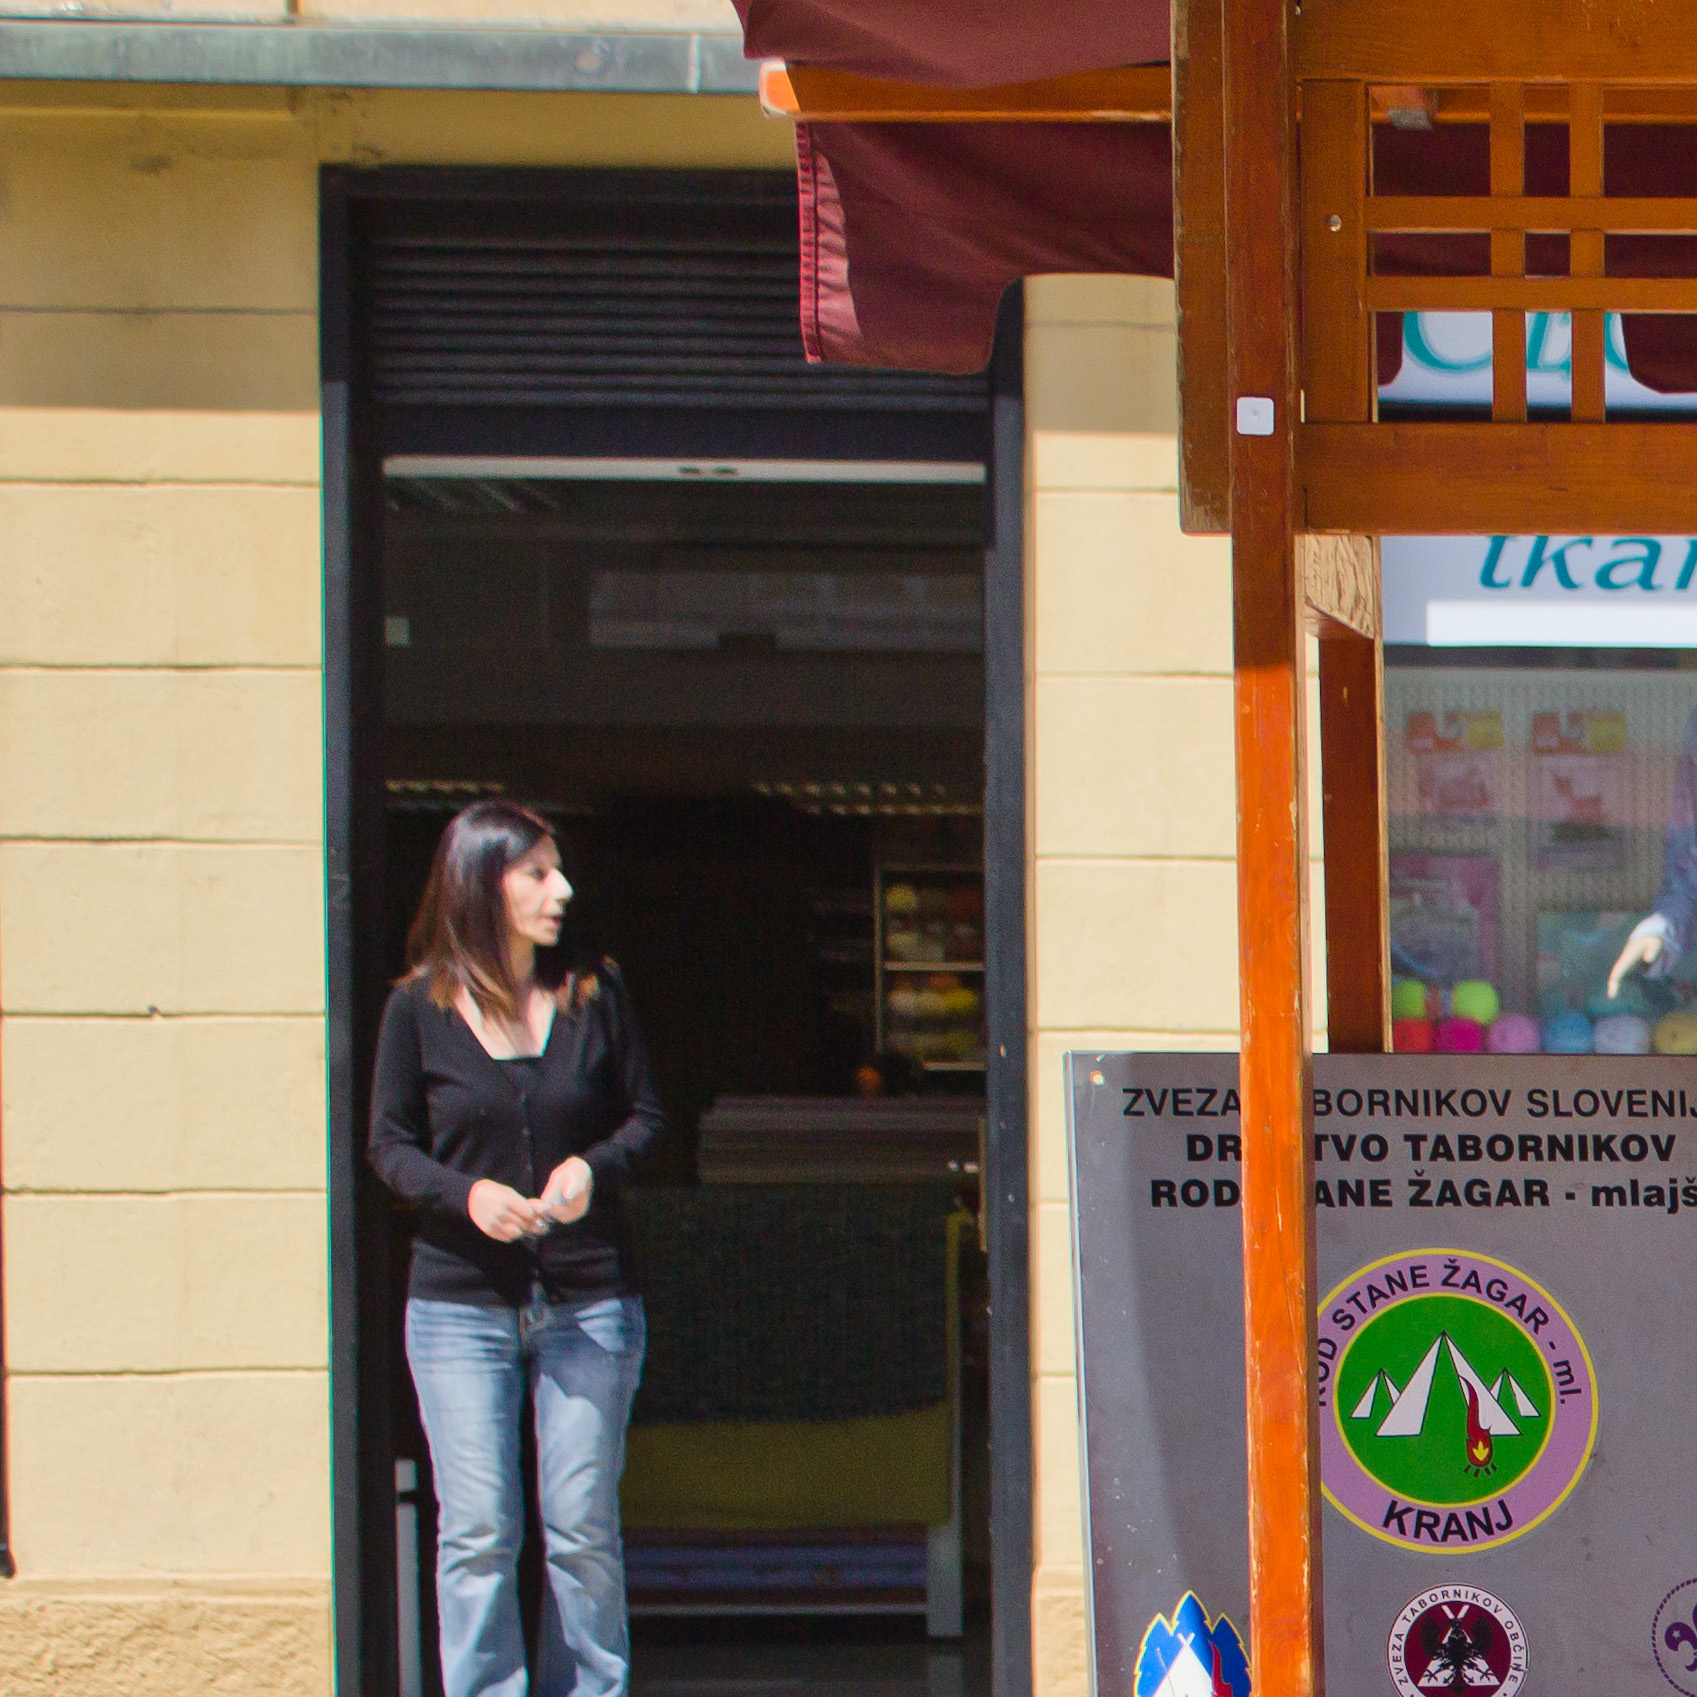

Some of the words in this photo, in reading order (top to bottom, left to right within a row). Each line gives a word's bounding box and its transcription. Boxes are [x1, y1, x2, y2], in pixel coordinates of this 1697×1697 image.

[1122, 1088, 1241, 1117] ZVEZA
[1313, 1088, 1512, 1118] BORNIKOV
[1186, 1133, 1389, 1163] DRTVO
[1403, 1133, 1677, 1163] TABORNIKOV
[1151, 1179, 1241, 1208] ROD
[1314, 1178, 1393, 1208] ANE
[1407, 1169, 1550, 1208] ŽAGAR
[1331, 1264, 1430, 1332] STANE
[1441, 1258, 1549, 1335] ŽAGAR
[1553, 1359, 1582, 1405] ml.
[1381, 1499, 1514, 1543] KRANJ
[1392, 1632, 1409, 1686] ZVEZA
[1402, 1588, 1503, 1624] TABORNIKOV
